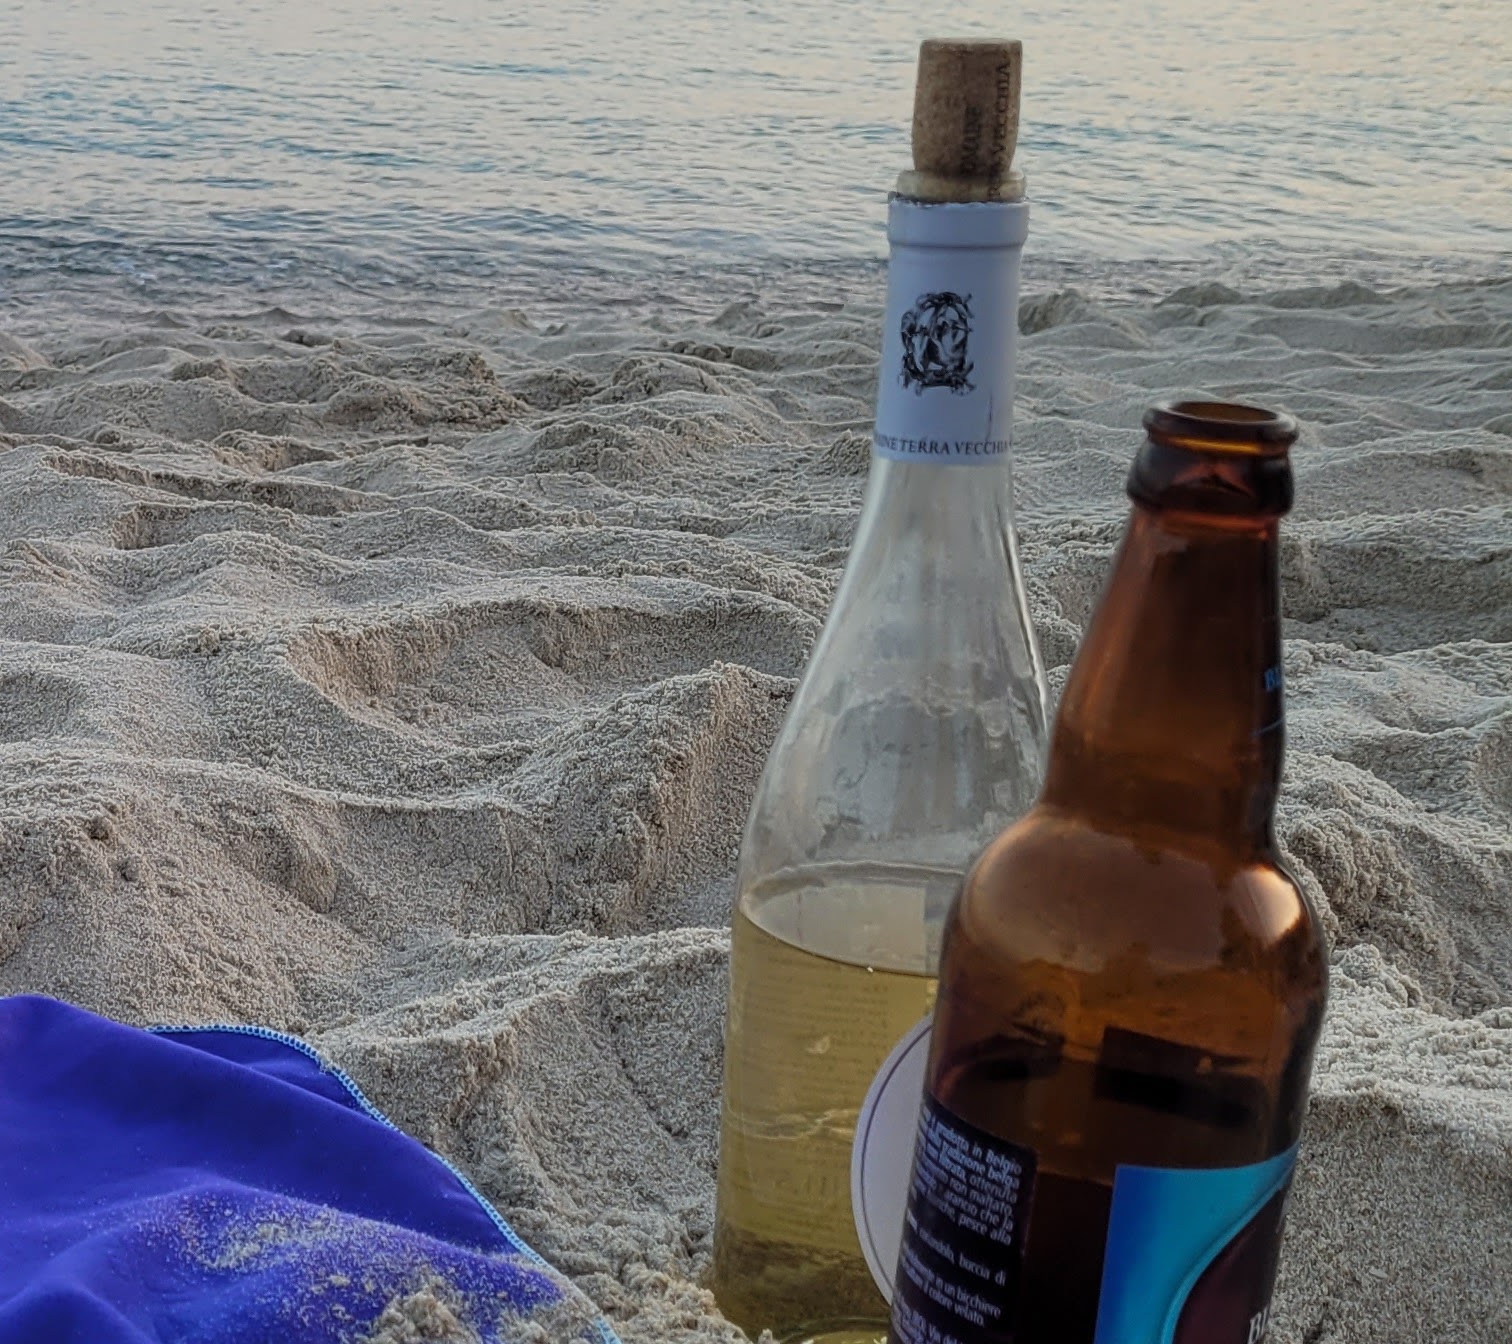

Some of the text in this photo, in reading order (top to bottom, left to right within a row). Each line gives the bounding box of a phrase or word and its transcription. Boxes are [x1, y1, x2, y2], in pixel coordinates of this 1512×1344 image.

[898, 439, 950, 455] TERRA
[955, 440, 1012, 456] VECCHI
[986, 1149, 1022, 1176] Belgio
[969, 1175, 1018, 1204] ottenuta
[988, 1167, 1020, 1190] belga
[958, 1213, 988, 1236] pesce
[990, 1227, 1012, 1246] alla
[980, 1206, 1000, 1225] che
[1002, 1215, 1014, 1233] la
[959, 1253, 991, 1281] buccia
[995, 1270, 1007, 1287] di
[956, 1287, 1001, 1319] bicchiere
